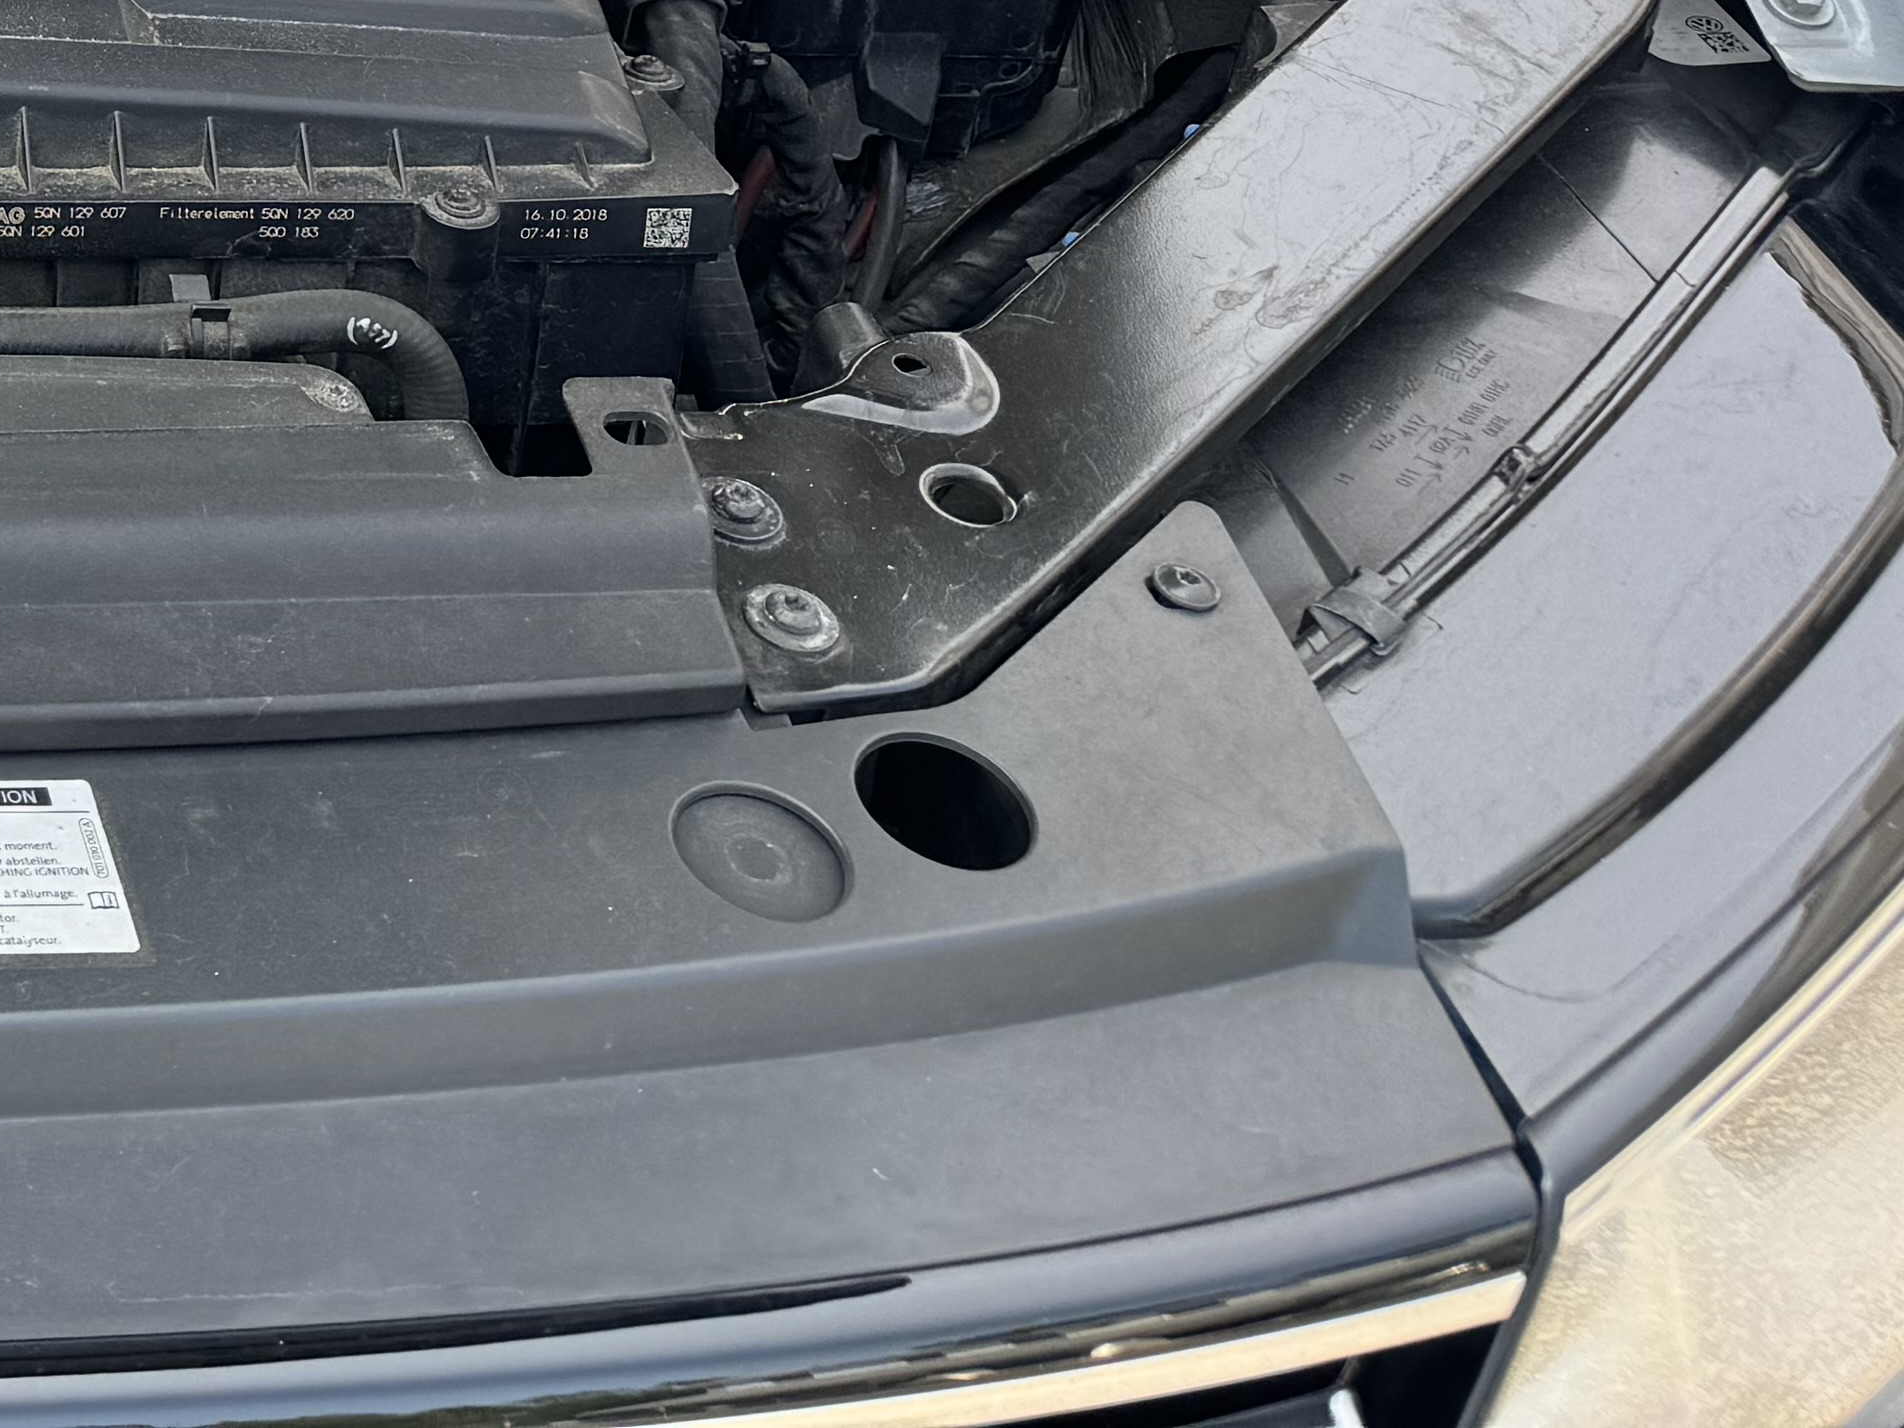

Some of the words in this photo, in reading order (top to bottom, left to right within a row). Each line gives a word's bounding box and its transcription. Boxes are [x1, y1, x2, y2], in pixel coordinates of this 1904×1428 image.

[34, 207, 62, 219] 5QN
[69, 207, 94, 219] 129
[101, 207, 127, 219] 607
[160, 207, 255, 220] Filterelement
[260, 208, 288, 220] 5QN
[296, 208, 322, 220] 129
[328, 208, 354, 220] 620
[30, 226, 55, 238] 129
[61, 226, 86, 238] 601
[294, 226, 319, 238] 183
[520, 227, 589, 240] 07:41:18
[35, 866, 89, 876] IGNITION
